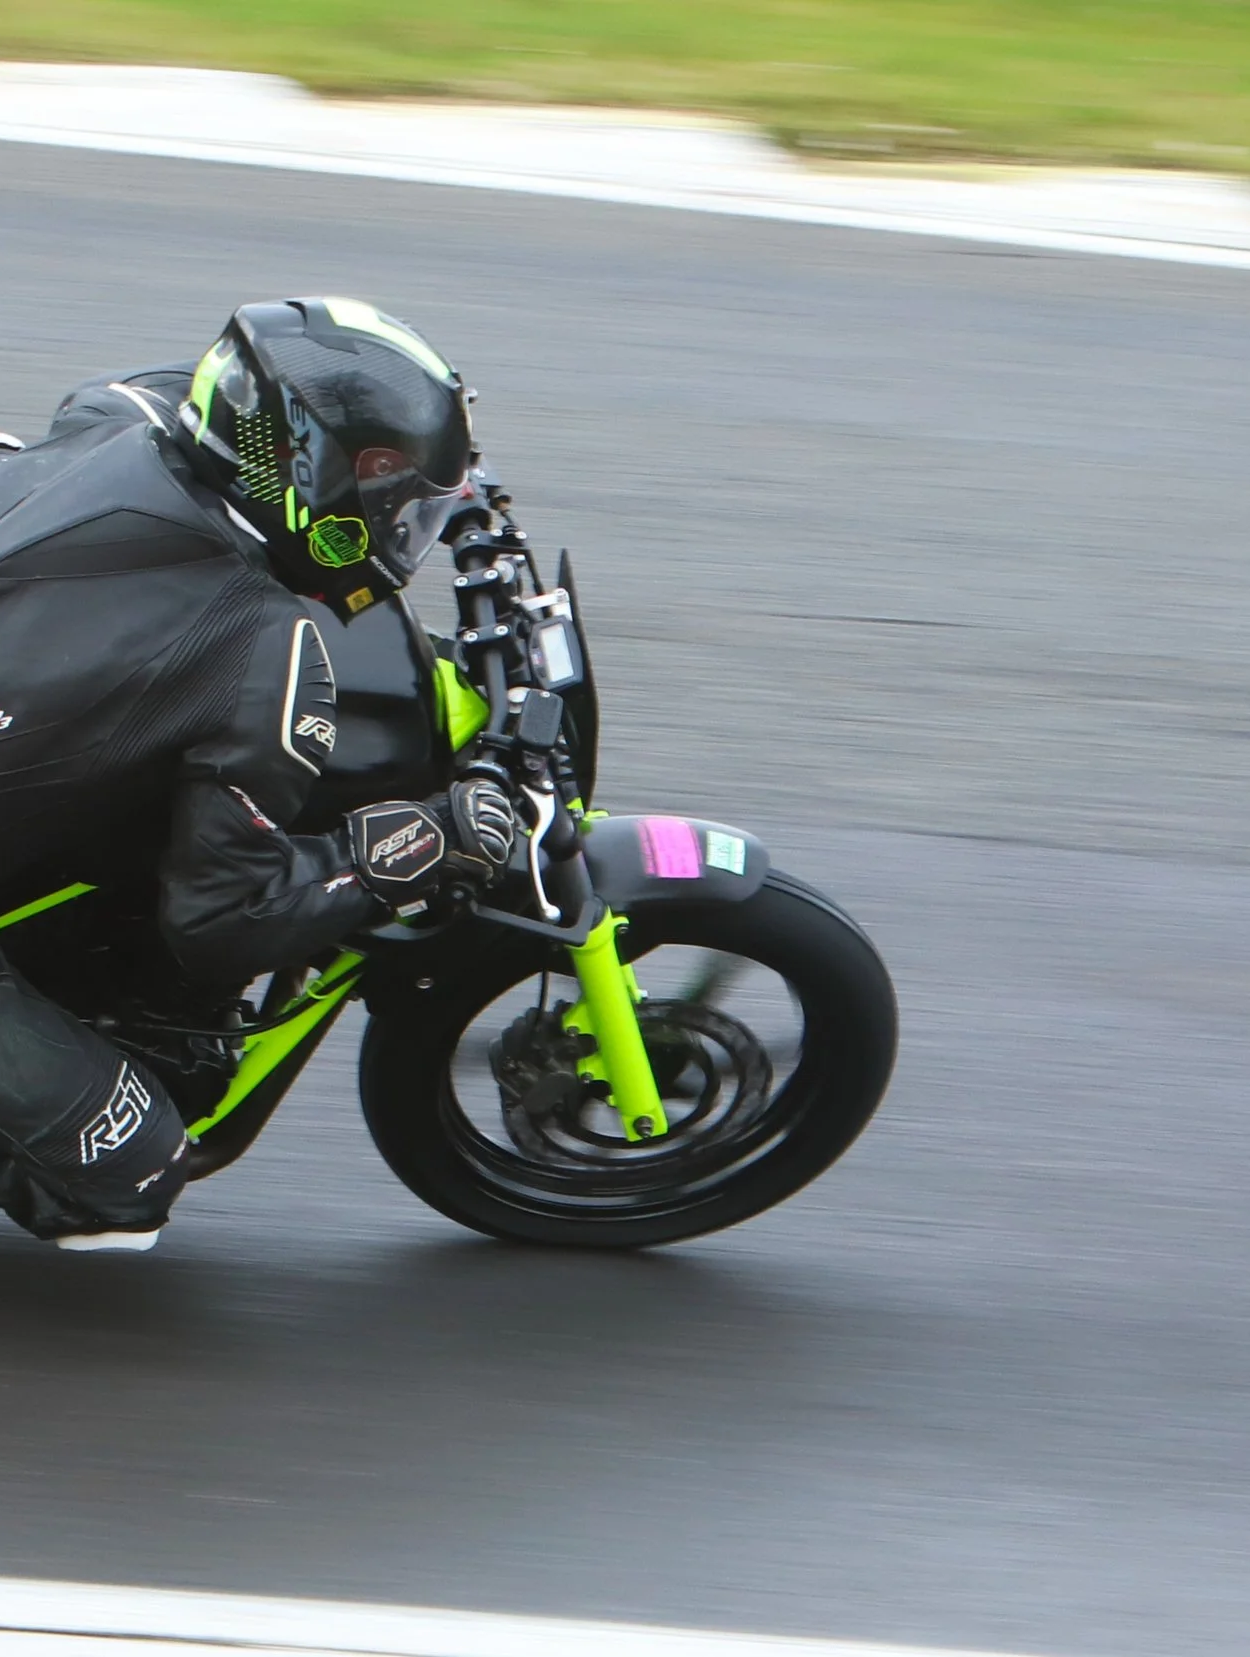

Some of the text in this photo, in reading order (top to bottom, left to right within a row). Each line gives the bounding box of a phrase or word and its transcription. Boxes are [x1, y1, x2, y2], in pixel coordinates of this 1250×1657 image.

[288, 399, 313, 488] EXO
[371, 819, 423, 864] RST
[80, 1060, 151, 1165] RST
